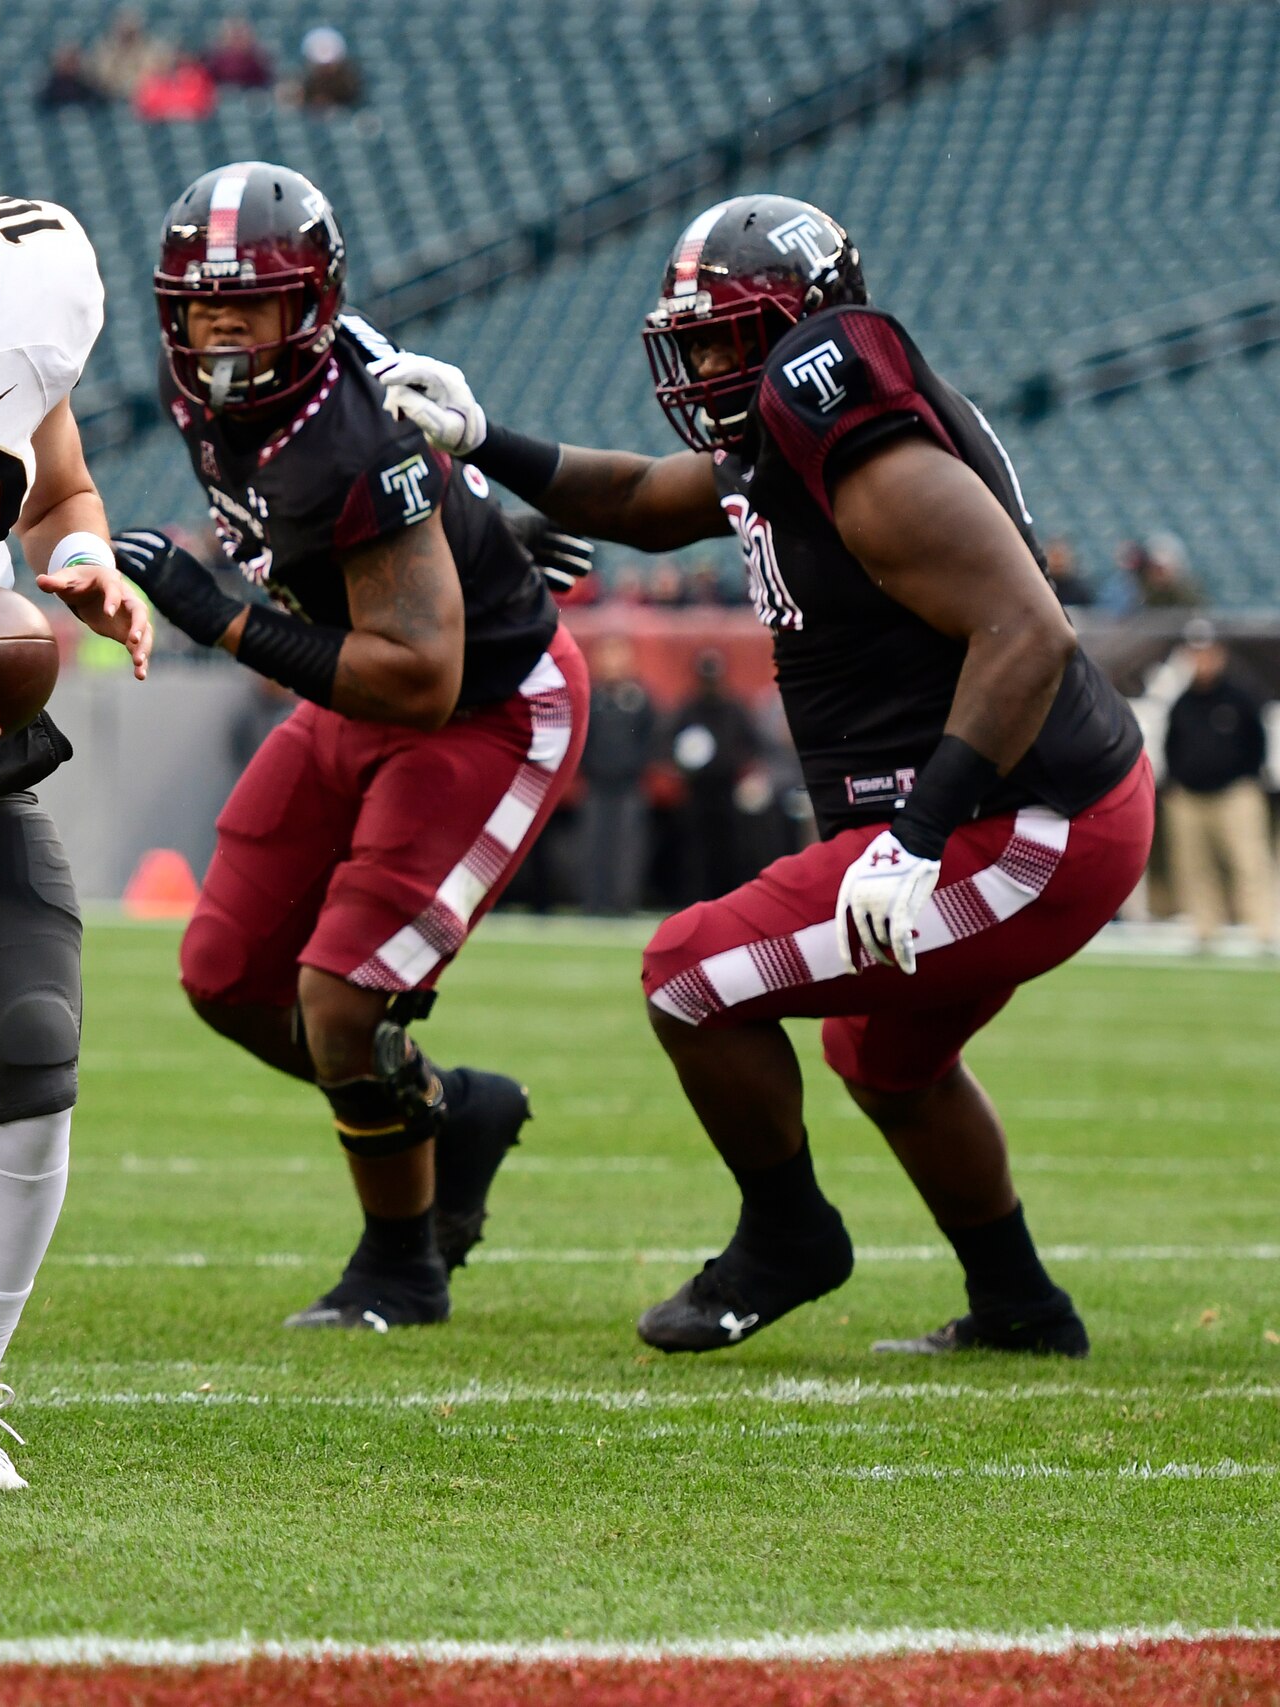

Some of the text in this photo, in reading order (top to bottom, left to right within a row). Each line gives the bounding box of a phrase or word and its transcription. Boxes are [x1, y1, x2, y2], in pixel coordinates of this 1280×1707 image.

[767, 213, 839, 284] T
[782, 339, 847, 413] T
[380, 453, 433, 526] T
[852, 776, 894, 794] TEMPLE
